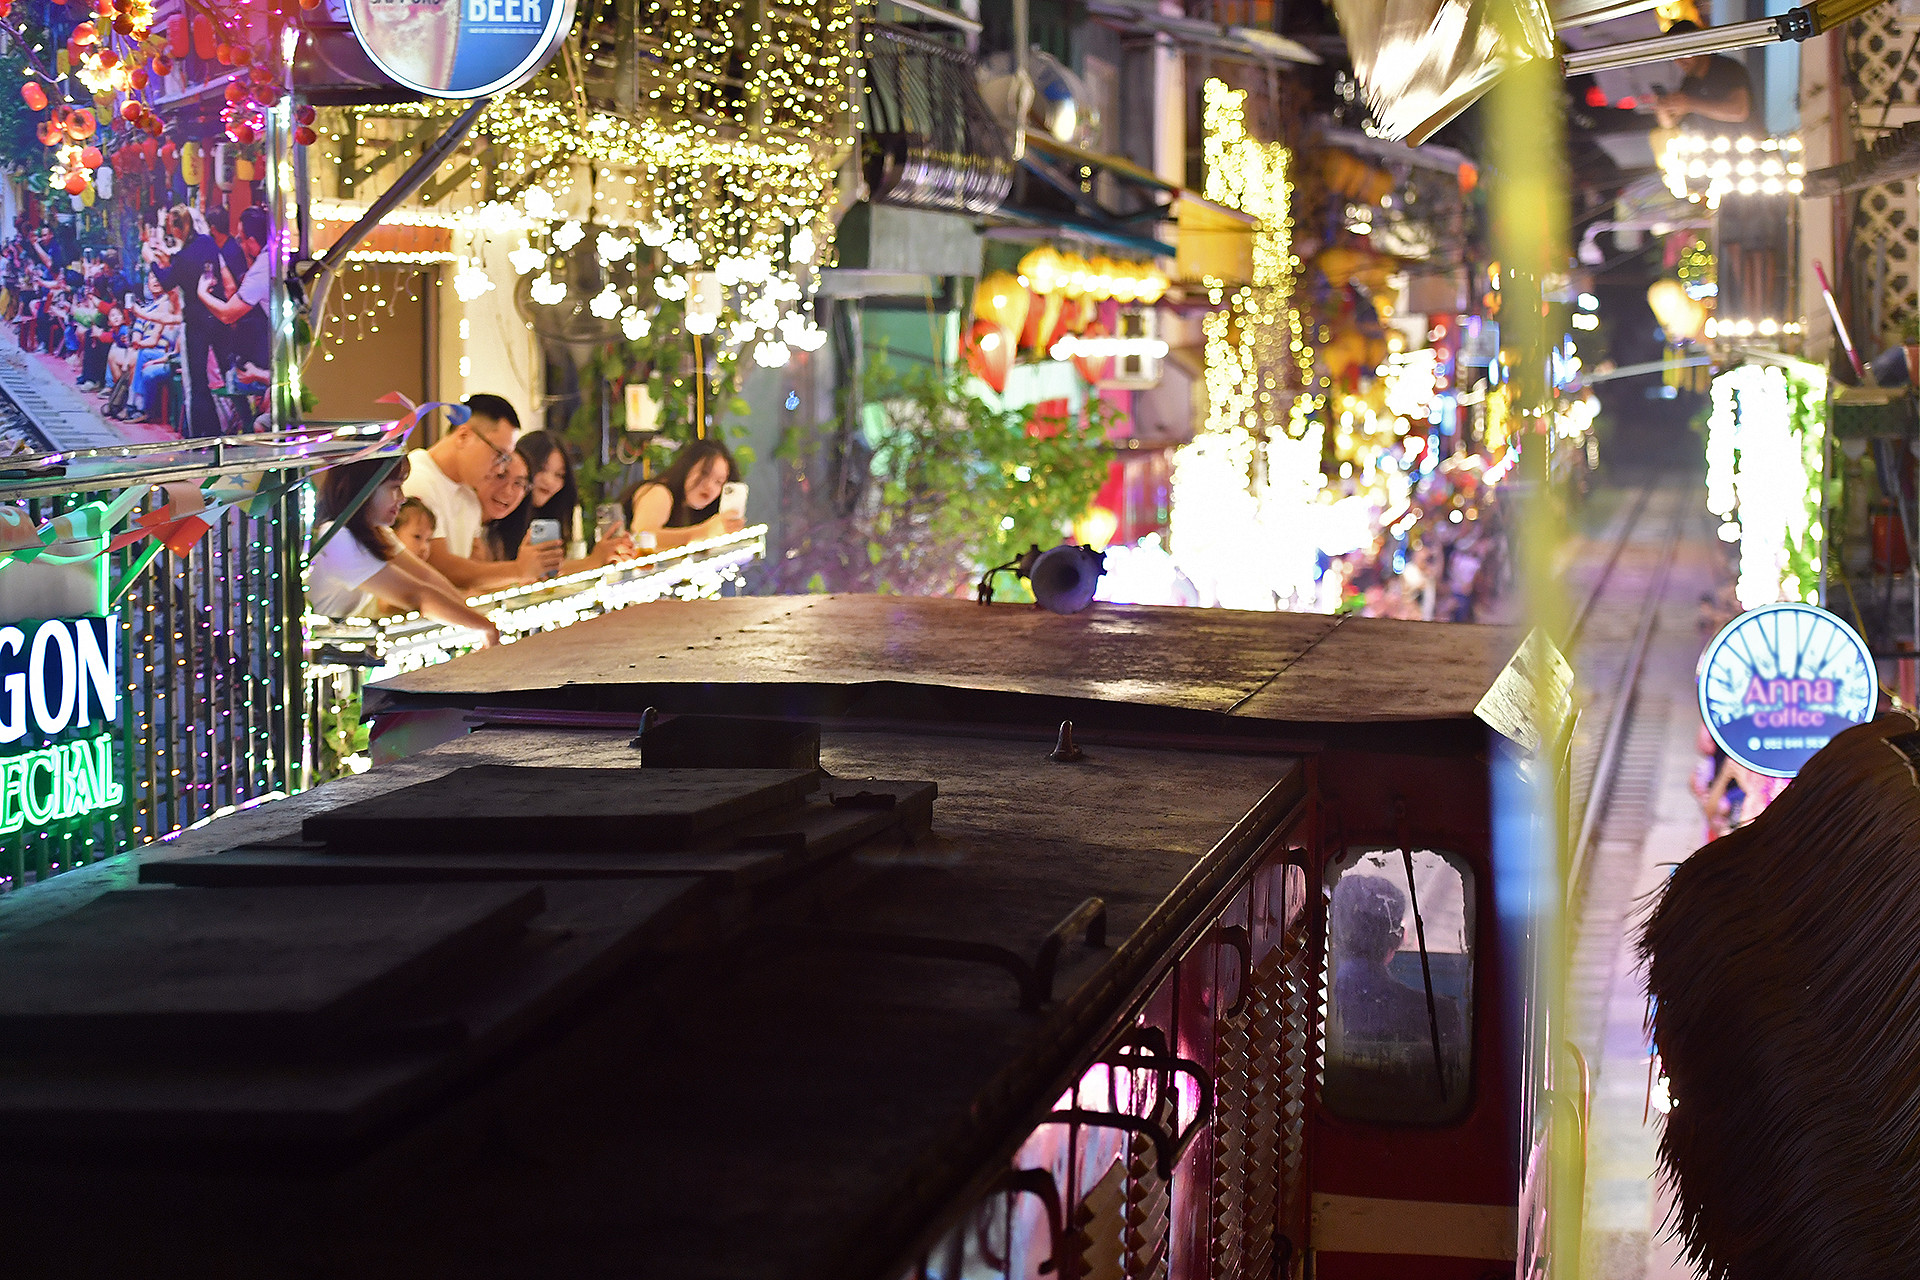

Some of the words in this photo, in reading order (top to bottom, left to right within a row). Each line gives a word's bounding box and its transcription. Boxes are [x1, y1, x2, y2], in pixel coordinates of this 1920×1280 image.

[468, 0, 541, 22] BEER
[0, 615, 117, 744] GON
[1744, 675, 1834, 704] Anna
[1752, 706, 1826, 728] coffee
